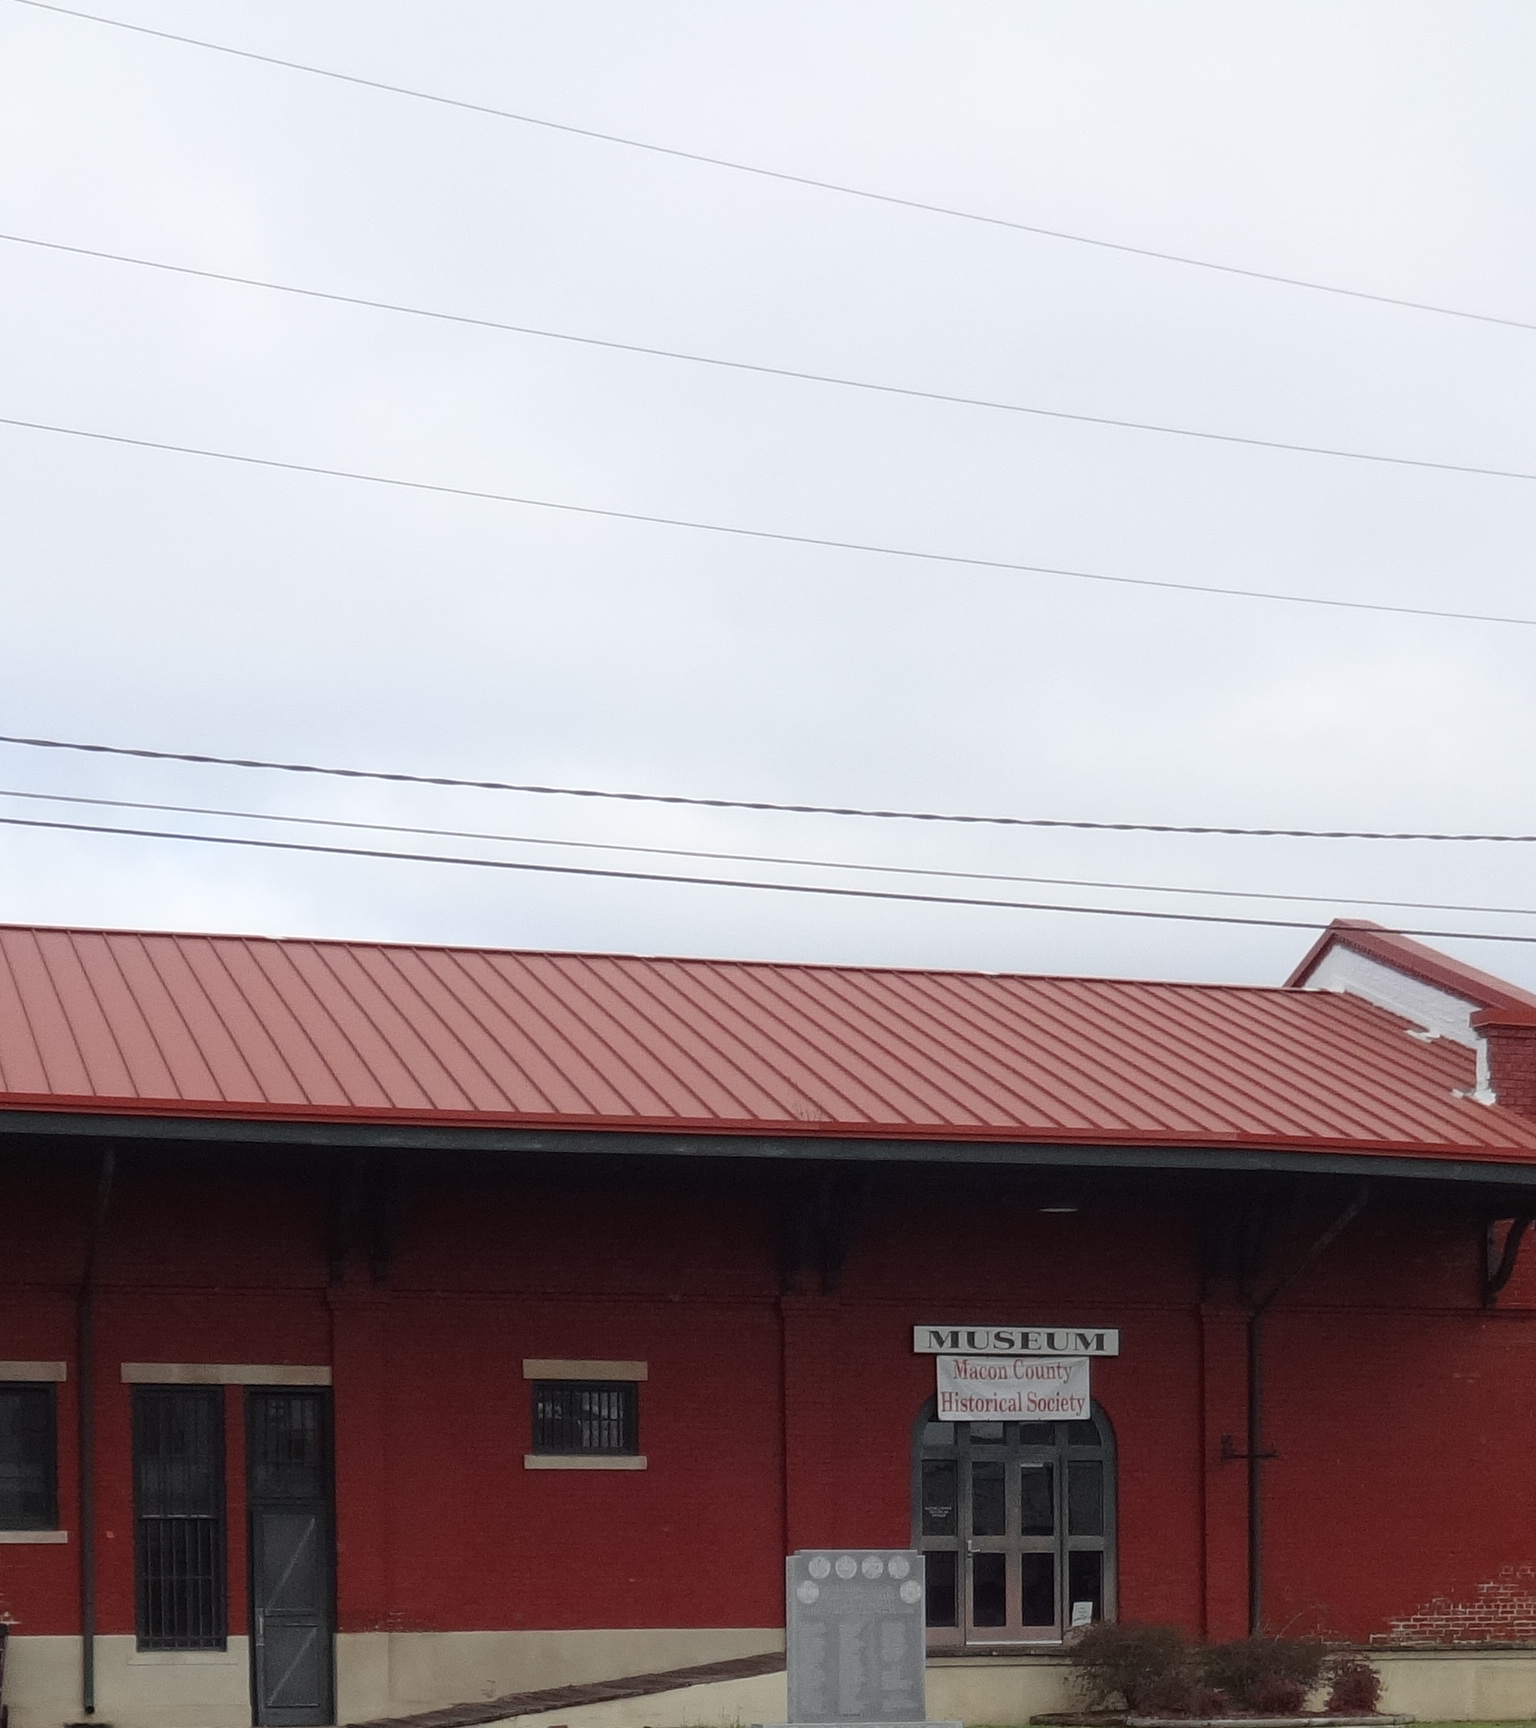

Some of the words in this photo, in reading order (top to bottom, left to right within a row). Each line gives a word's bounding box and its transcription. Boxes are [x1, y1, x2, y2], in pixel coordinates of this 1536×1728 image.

[928, 1330, 1106, 1351] MUSEUM
[953, 1359, 1008, 1380] Macon
[1014, 1358, 1073, 1384] County
[941, 1391, 1022, 1413] Historical
[1027, 1391, 1086, 1416] Society
